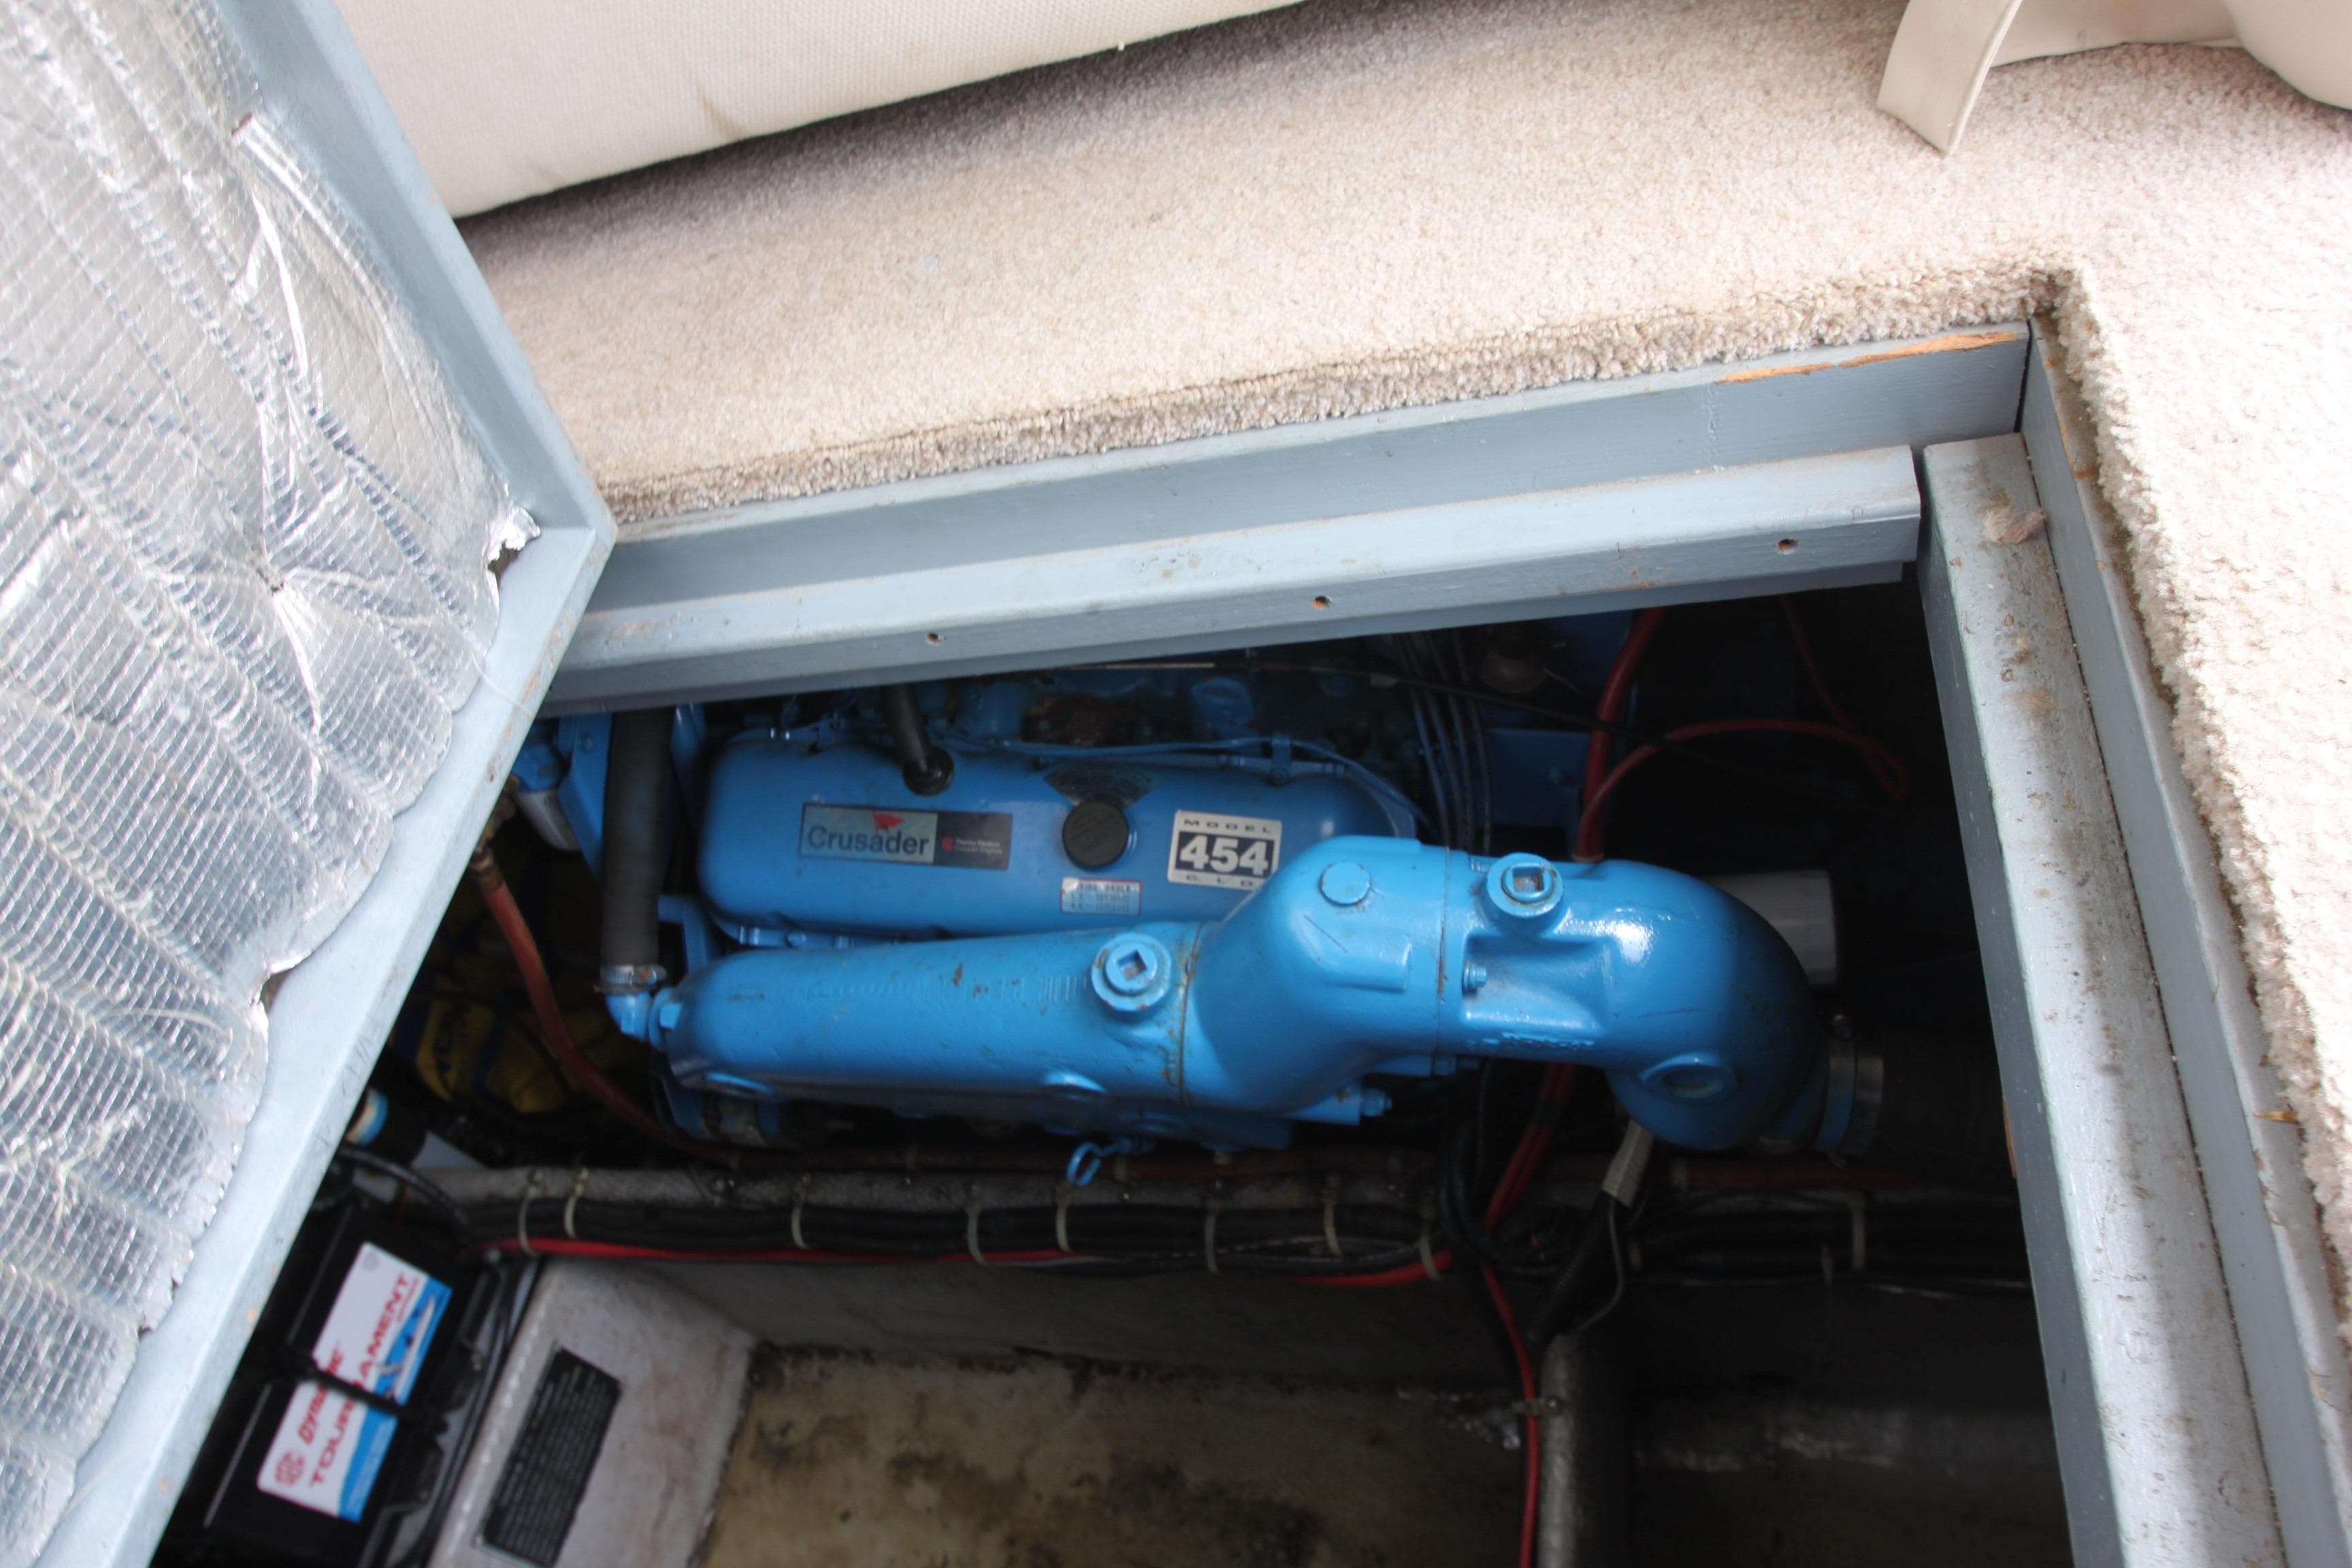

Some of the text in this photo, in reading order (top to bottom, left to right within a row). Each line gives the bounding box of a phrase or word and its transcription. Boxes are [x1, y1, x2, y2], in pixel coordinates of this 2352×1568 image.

[807, 824, 930, 855] Crusader
[1184, 819, 1271, 833] MODEL
[1179, 834, 1269, 877] 454
